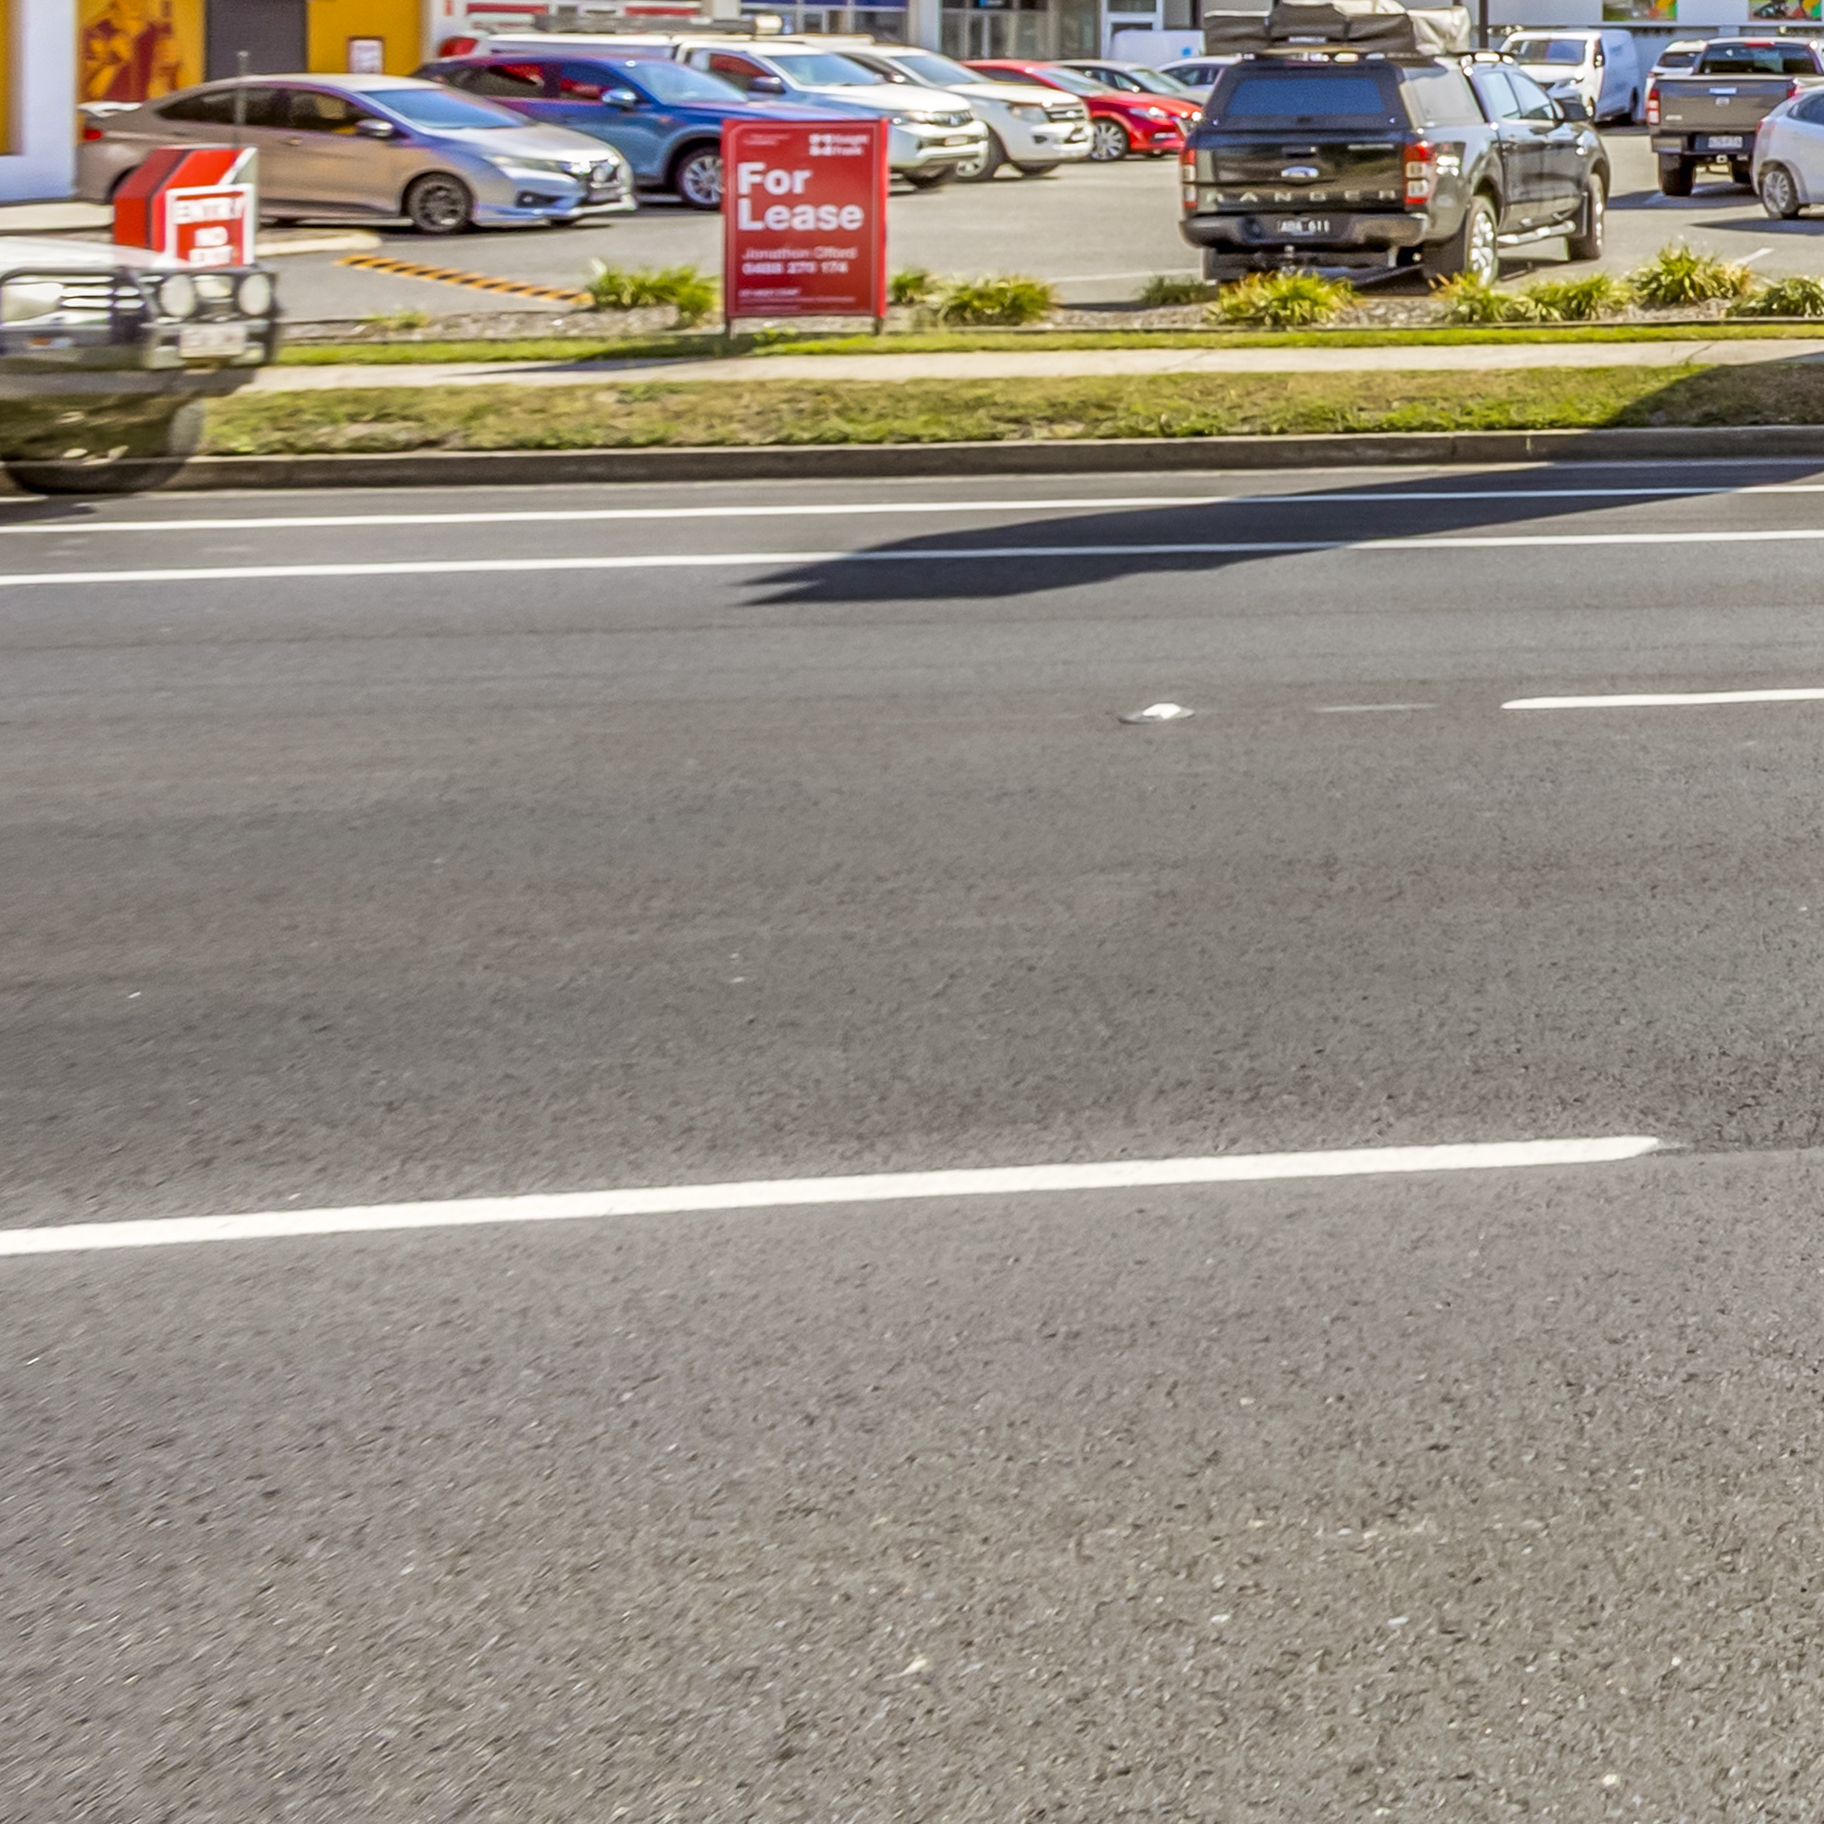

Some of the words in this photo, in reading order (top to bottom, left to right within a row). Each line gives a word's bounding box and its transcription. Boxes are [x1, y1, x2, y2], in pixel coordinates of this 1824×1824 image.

[738, 161, 813, 196] For
[1206, 189, 1396, 203] RANGER
[738, 197, 865, 231] Lease
